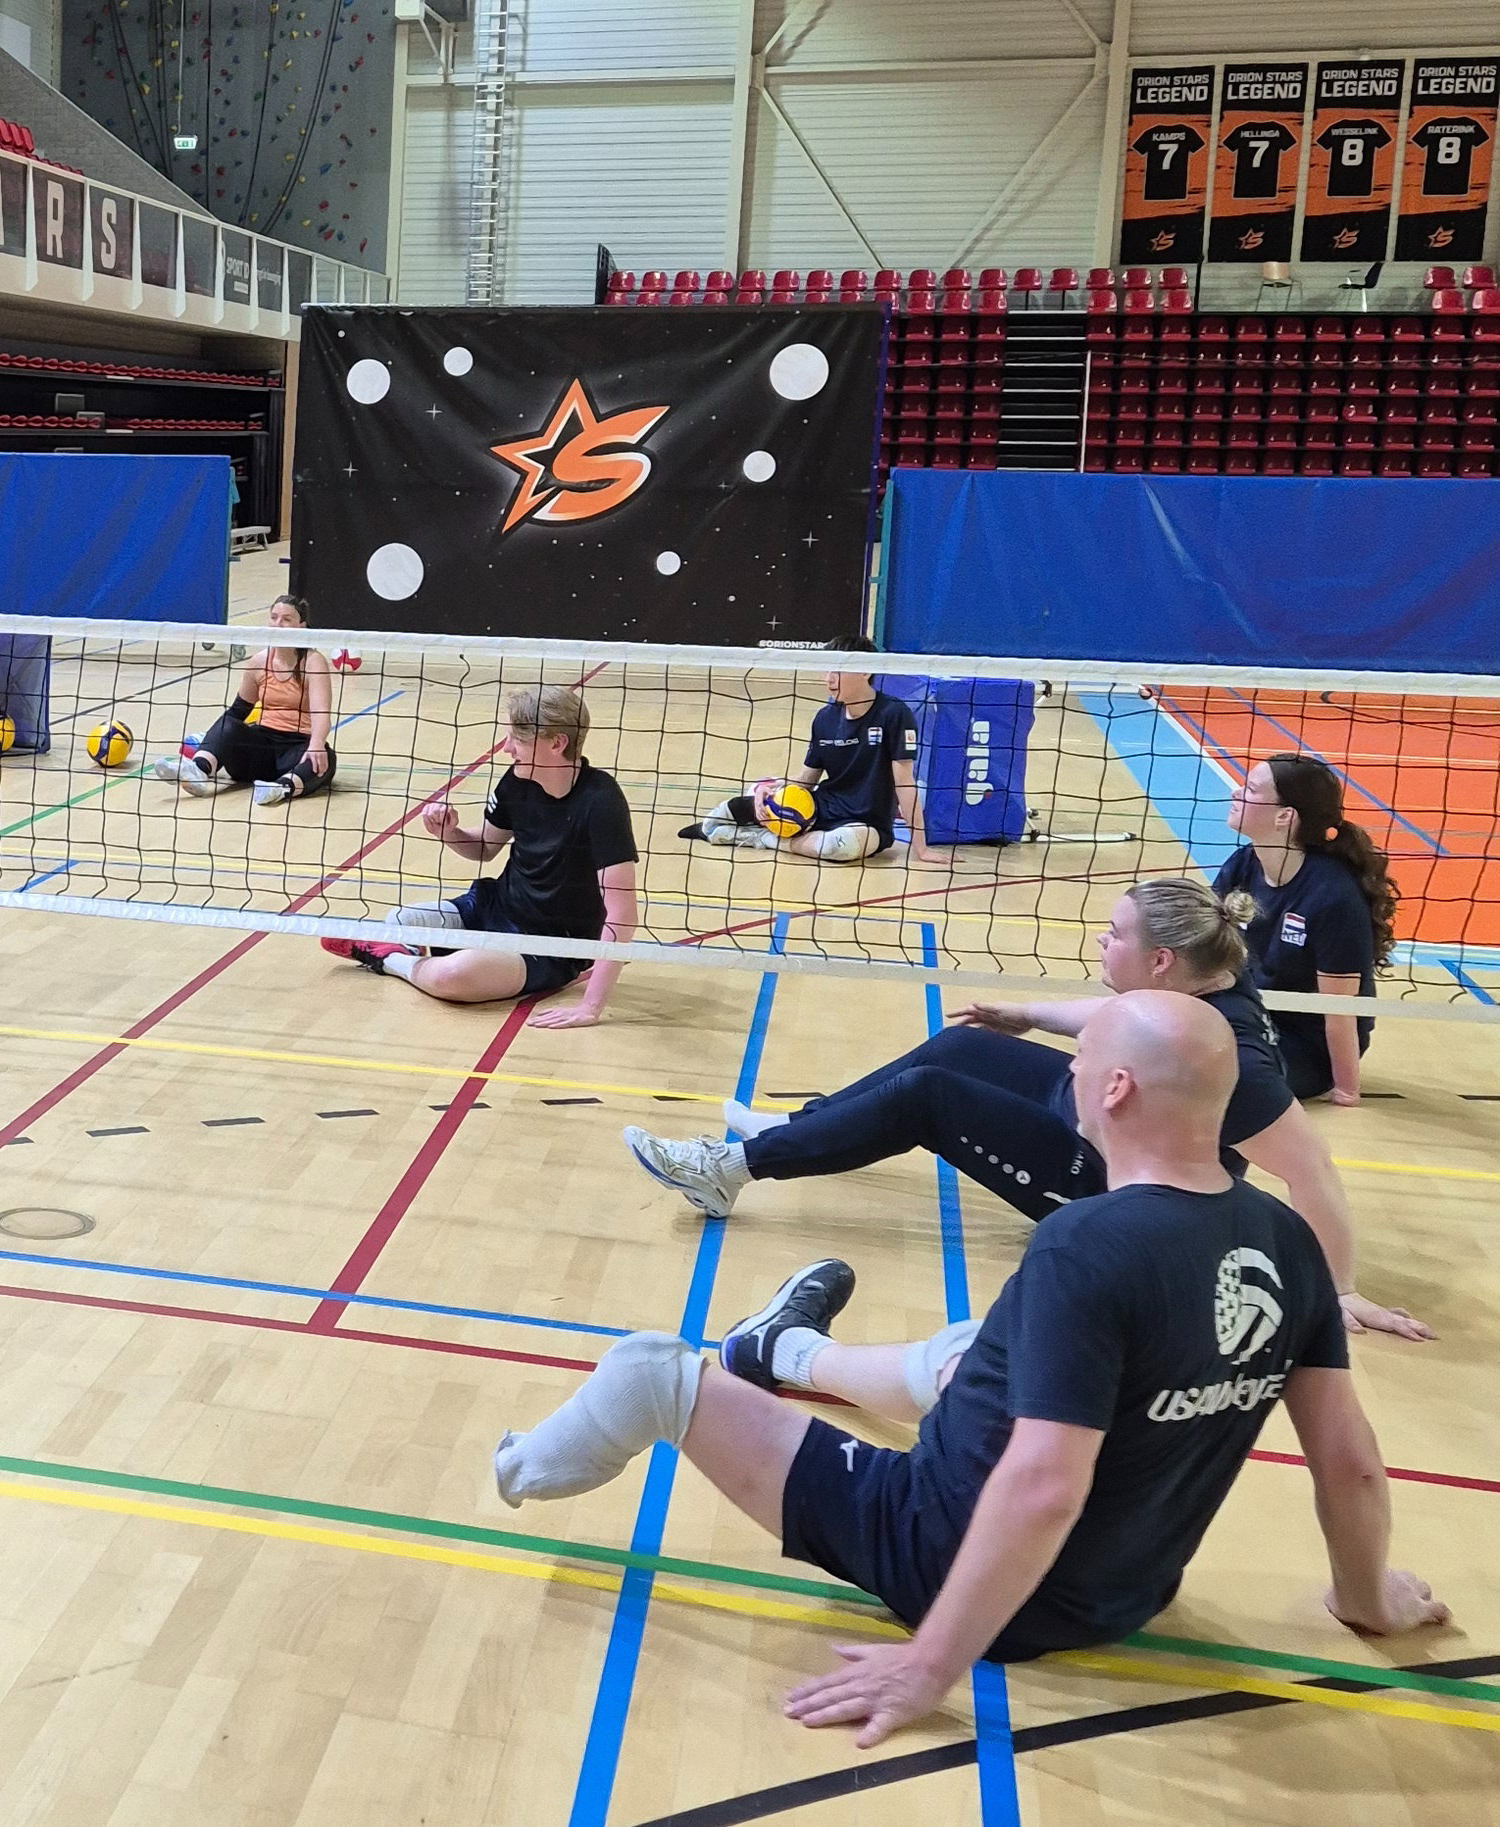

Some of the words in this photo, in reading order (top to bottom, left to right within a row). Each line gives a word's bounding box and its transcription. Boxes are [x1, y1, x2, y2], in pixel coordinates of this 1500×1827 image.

[1228, 72, 1263, 83] ORION
[1265, 71, 1303, 82] STARS
[1322, 69, 1358, 80] ORION
[1361, 68, 1399, 79] STARS
[1418, 66, 1456, 77] ORION
[1458, 65, 1497, 76] STARS
[1137, 77, 1171, 87] ORION
[1173, 74, 1209, 85] STARS
[1321, 80, 1398, 98] LEGEND
[1417, 77, 1496, 95] LEGEND
[1136, 86, 1208, 104] LEGEND
[1227, 83, 1301, 100] LEGEND
[1152, 132, 1186, 142] KAMPS
[1158, 143, 1179, 170] 7
[1249, 141, 1270, 168] 7
[1341, 138, 1365, 166] 8
[1437, 136, 1461, 164] 8
[759, 639, 828, 650] #ORIONSTAR
[965, 720, 994, 806] gala
